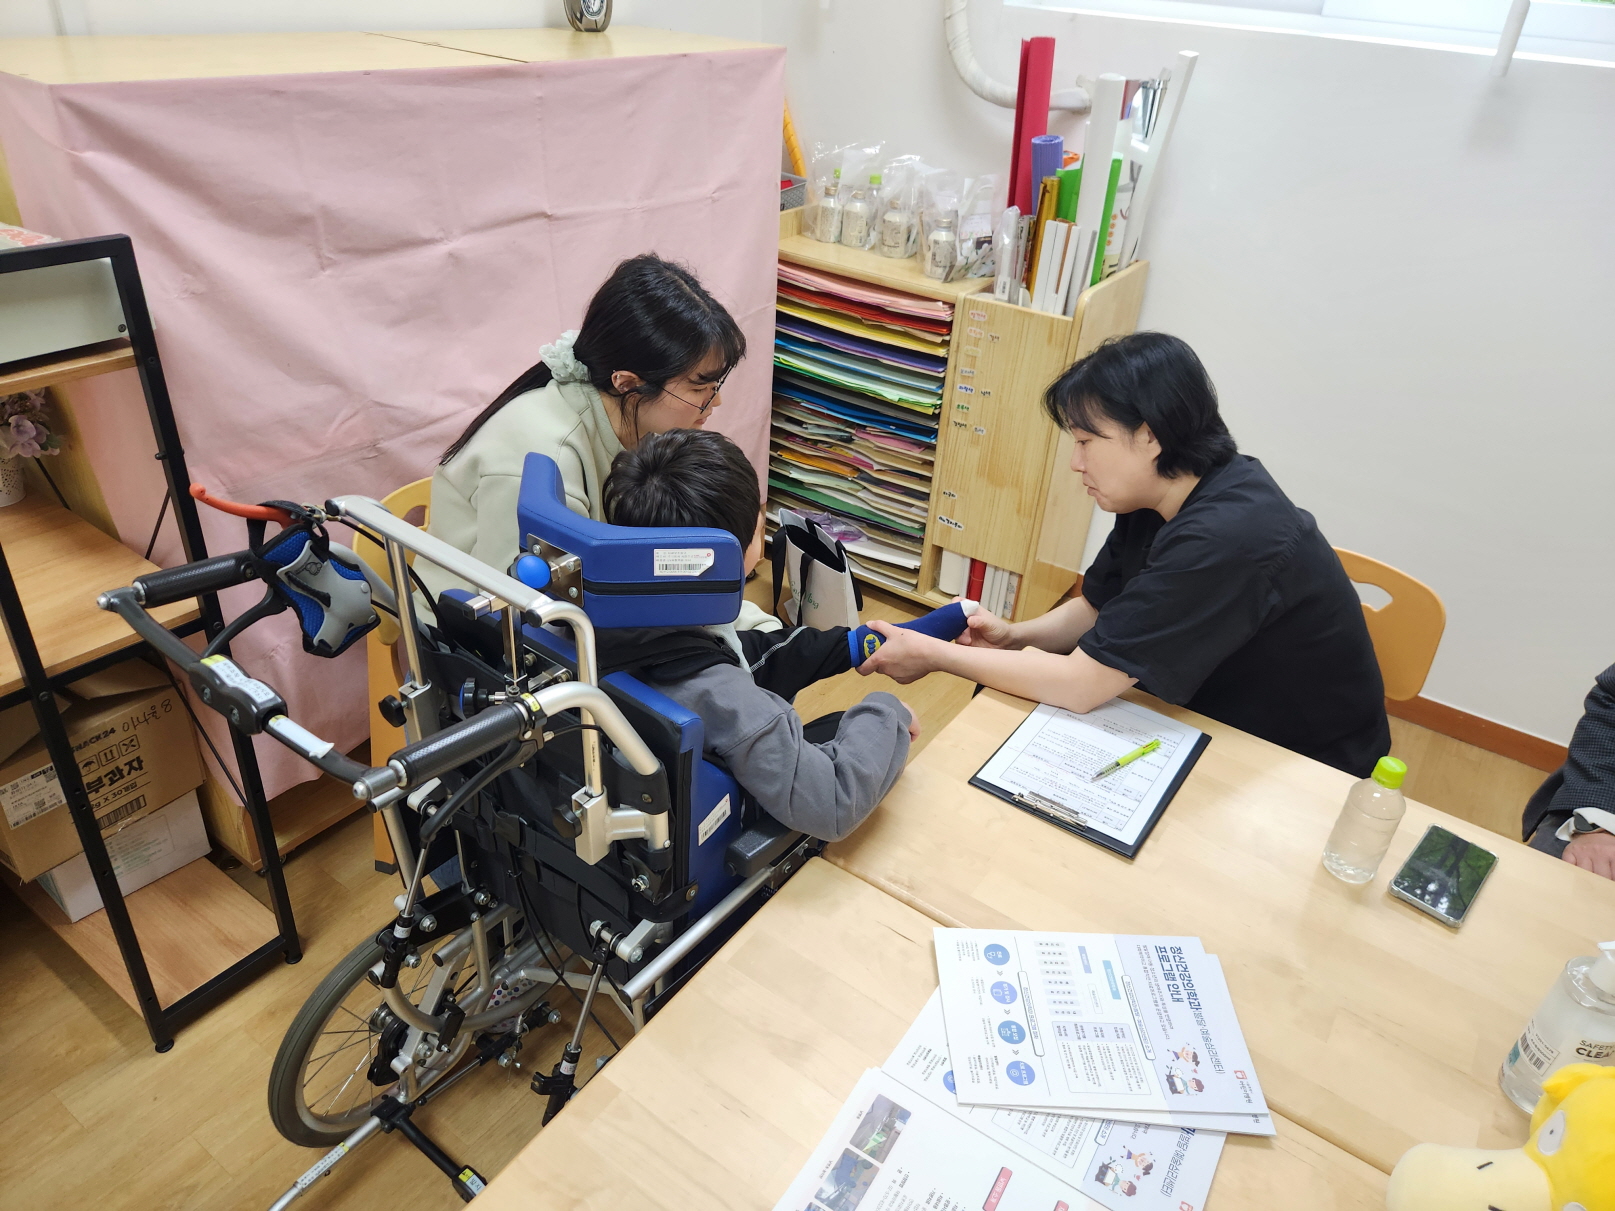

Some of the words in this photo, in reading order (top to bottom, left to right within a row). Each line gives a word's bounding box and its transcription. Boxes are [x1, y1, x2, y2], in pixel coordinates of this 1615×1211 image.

[84, 756, 144, 795] 부과자
[1154, 946, 1176, 981] 프로그램
[1166, 984, 1184, 1003] 안내
[1579, 1039, 1614, 1051] SAFETY
[1159, 1125, 1196, 1198] (발달·예술심리센터)
